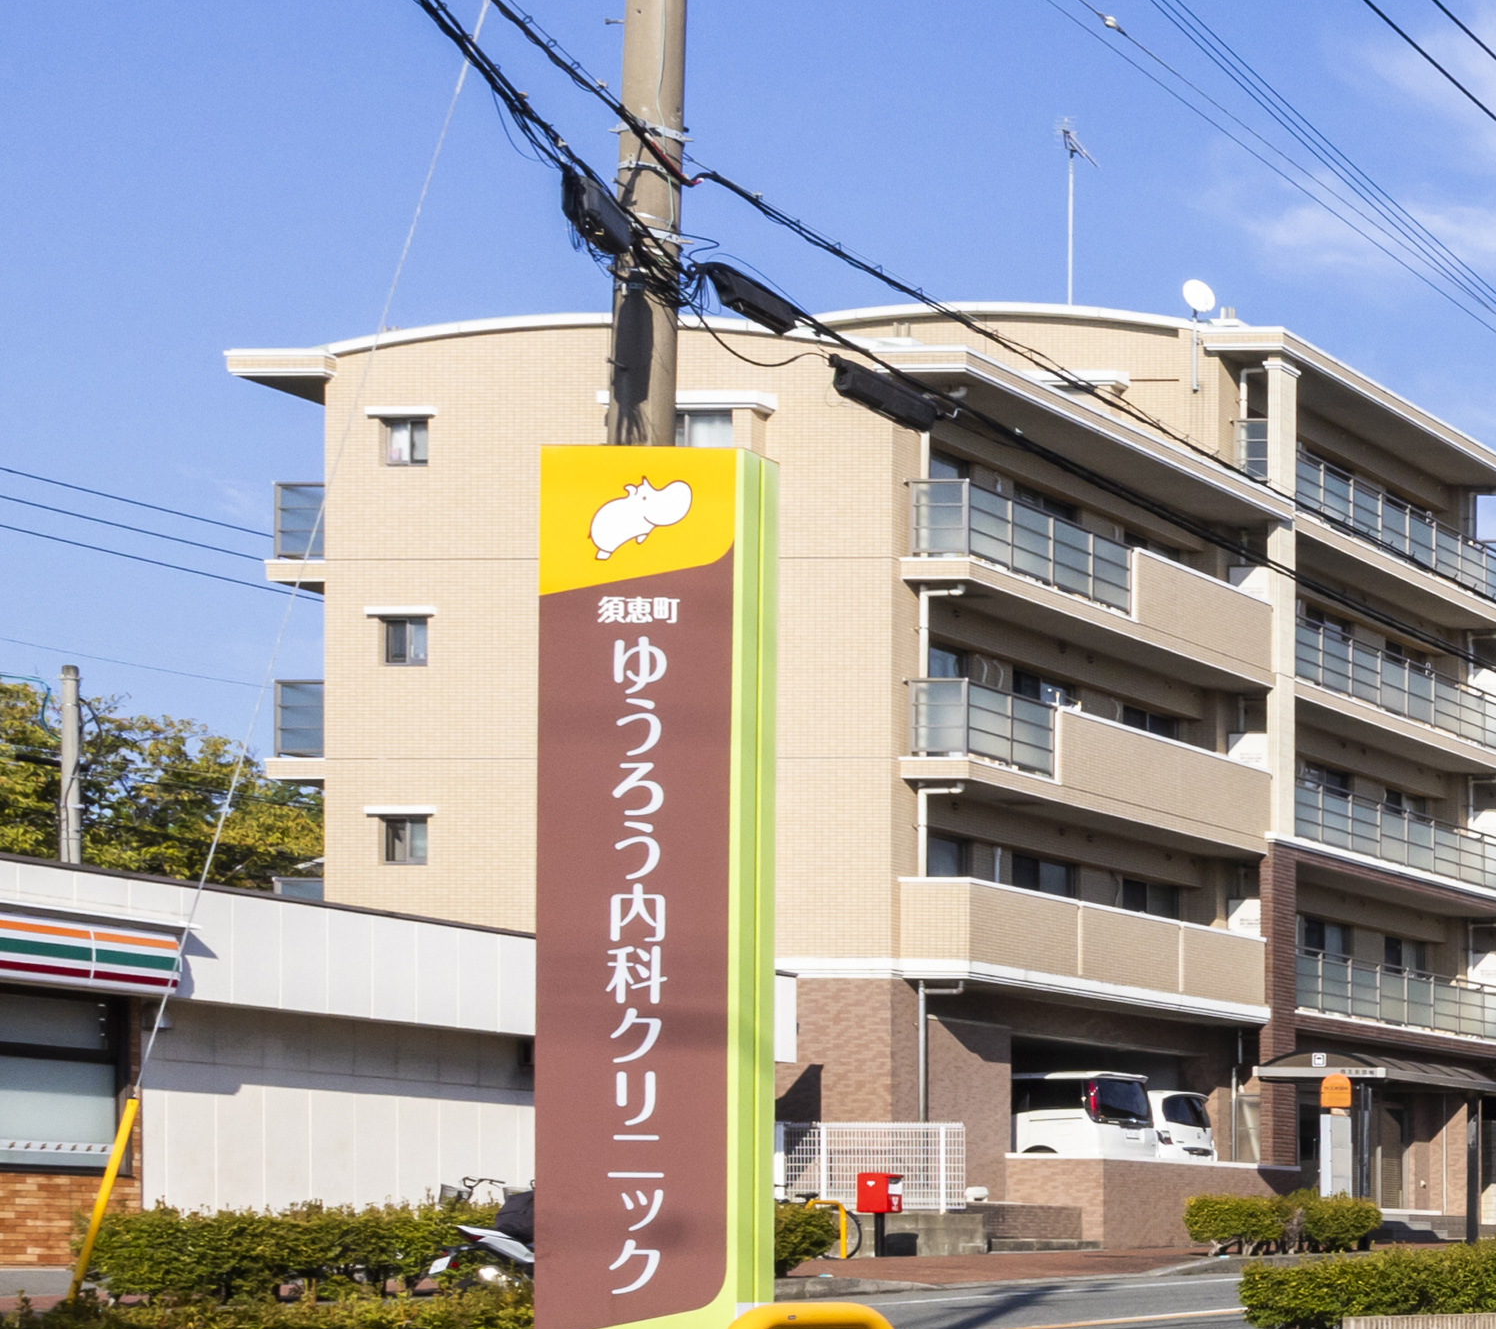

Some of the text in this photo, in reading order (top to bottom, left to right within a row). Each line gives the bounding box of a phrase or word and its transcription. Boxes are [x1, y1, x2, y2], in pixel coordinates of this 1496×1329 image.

[597, 596, 681, 624] 須恵町
[605, 636, 668, 1295] ゆうろう内科クリニック
